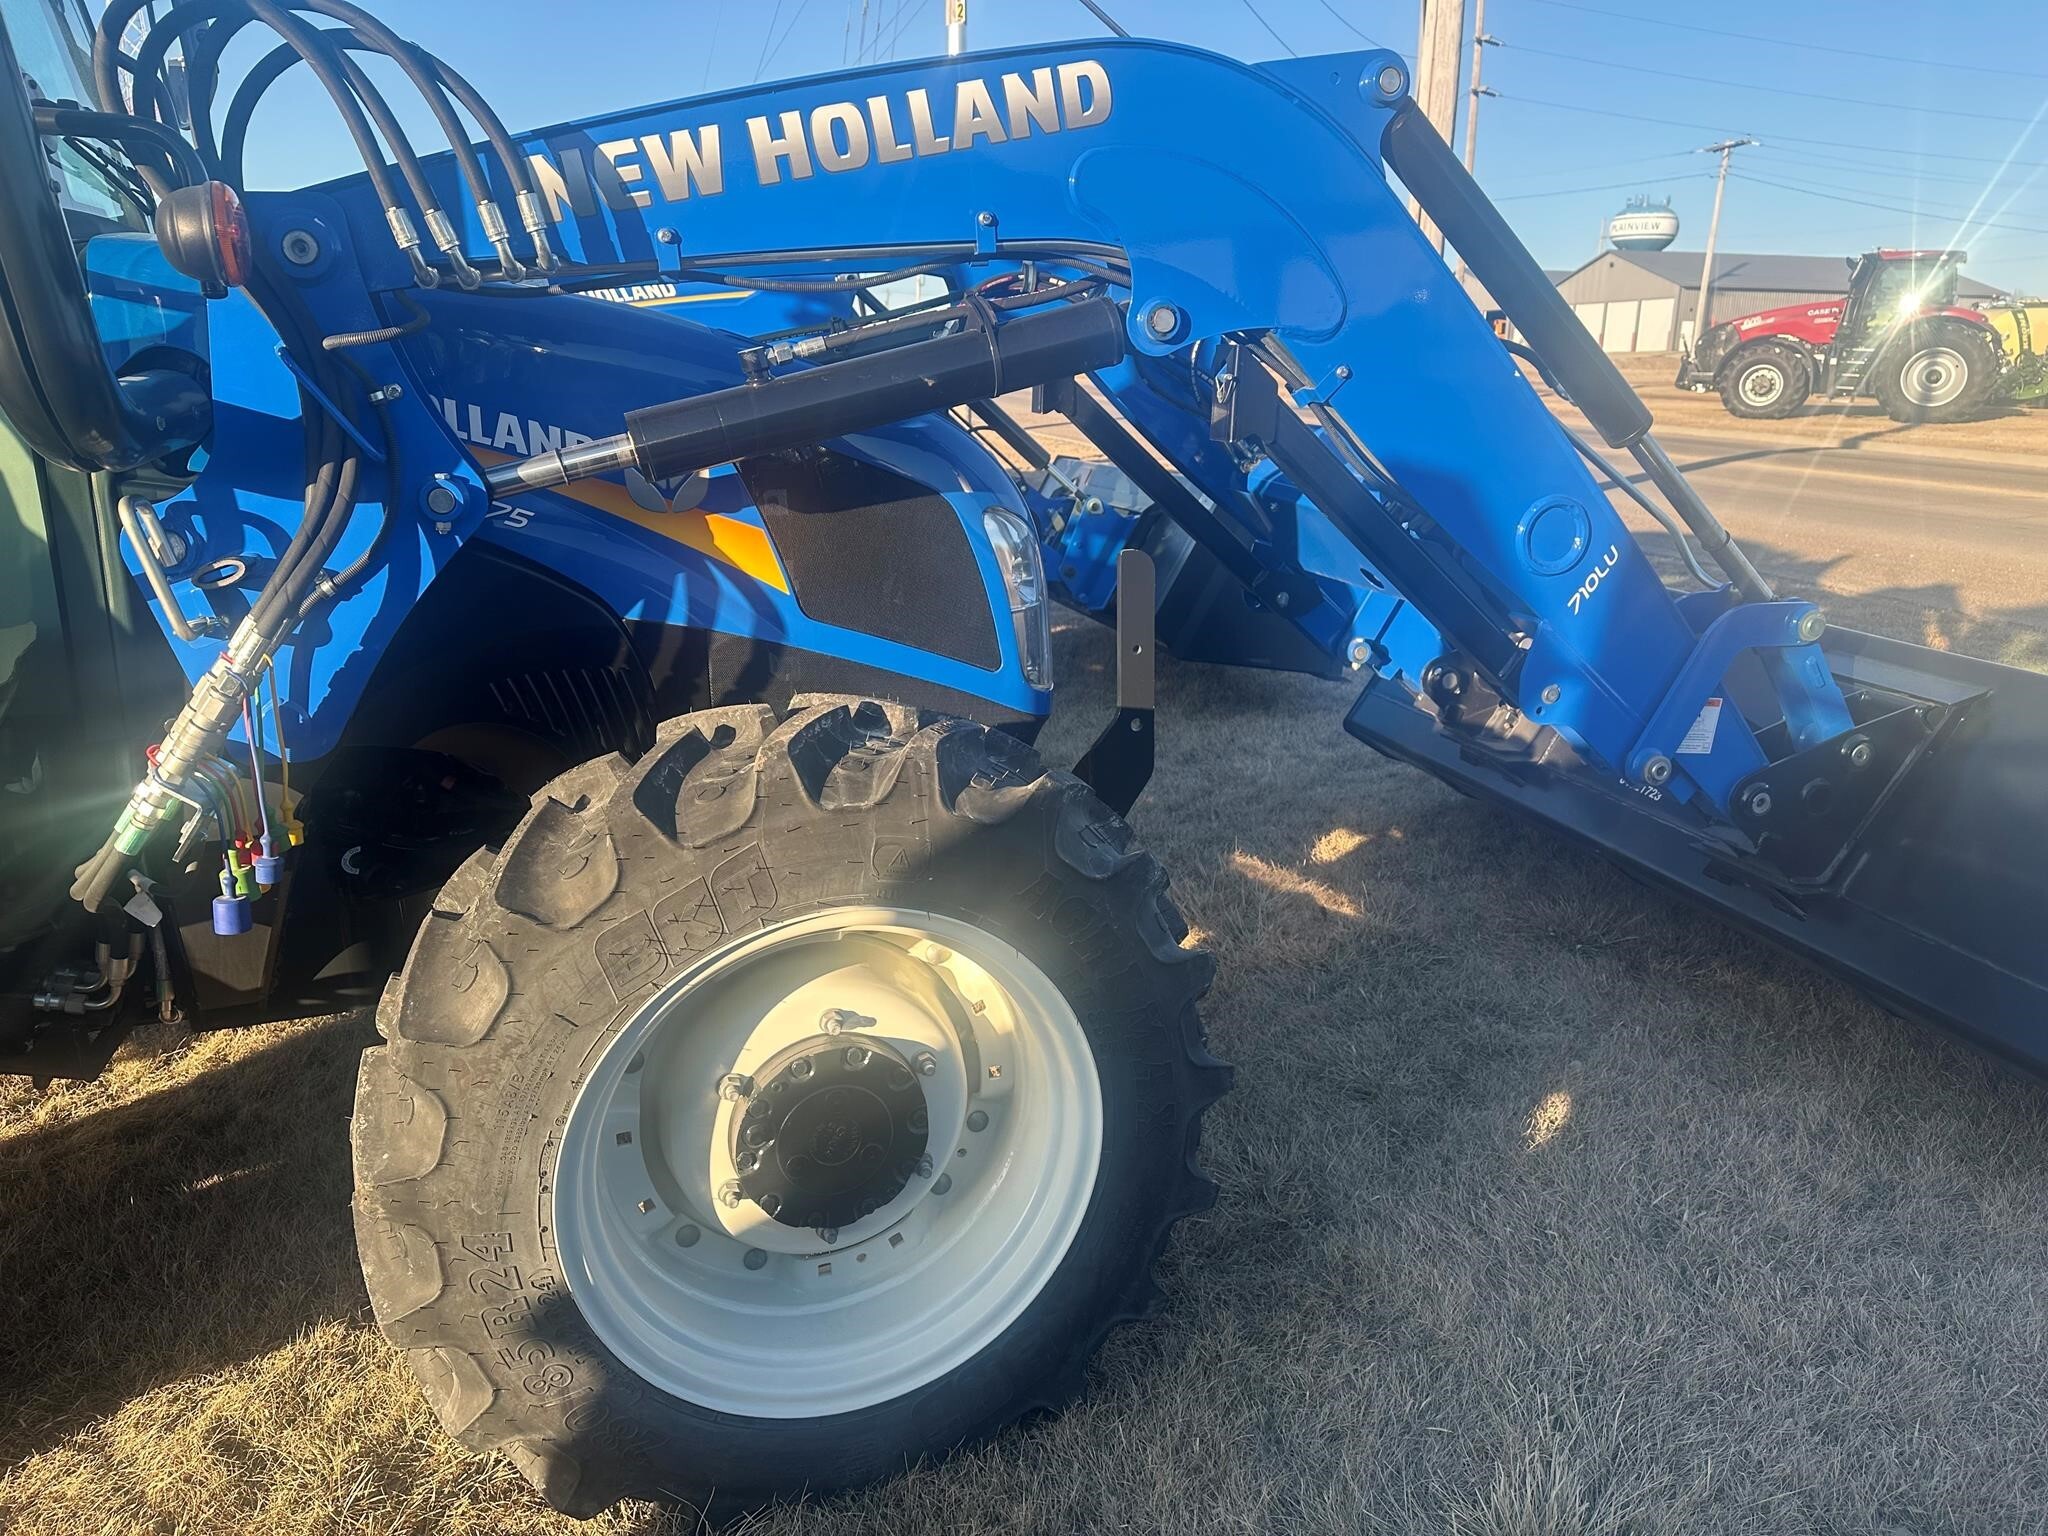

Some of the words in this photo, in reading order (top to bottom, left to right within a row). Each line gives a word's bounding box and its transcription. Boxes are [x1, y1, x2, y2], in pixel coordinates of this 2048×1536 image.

[957, 3, 964, 18] 2
[524, 124, 724, 225] NEW
[746, 60, 1112, 185] HOLLAND
[1611, 222, 1661, 232] PLAINVIEW
[485, 501, 535, 528] 75
[1567, 544, 1619, 616] 710LU
